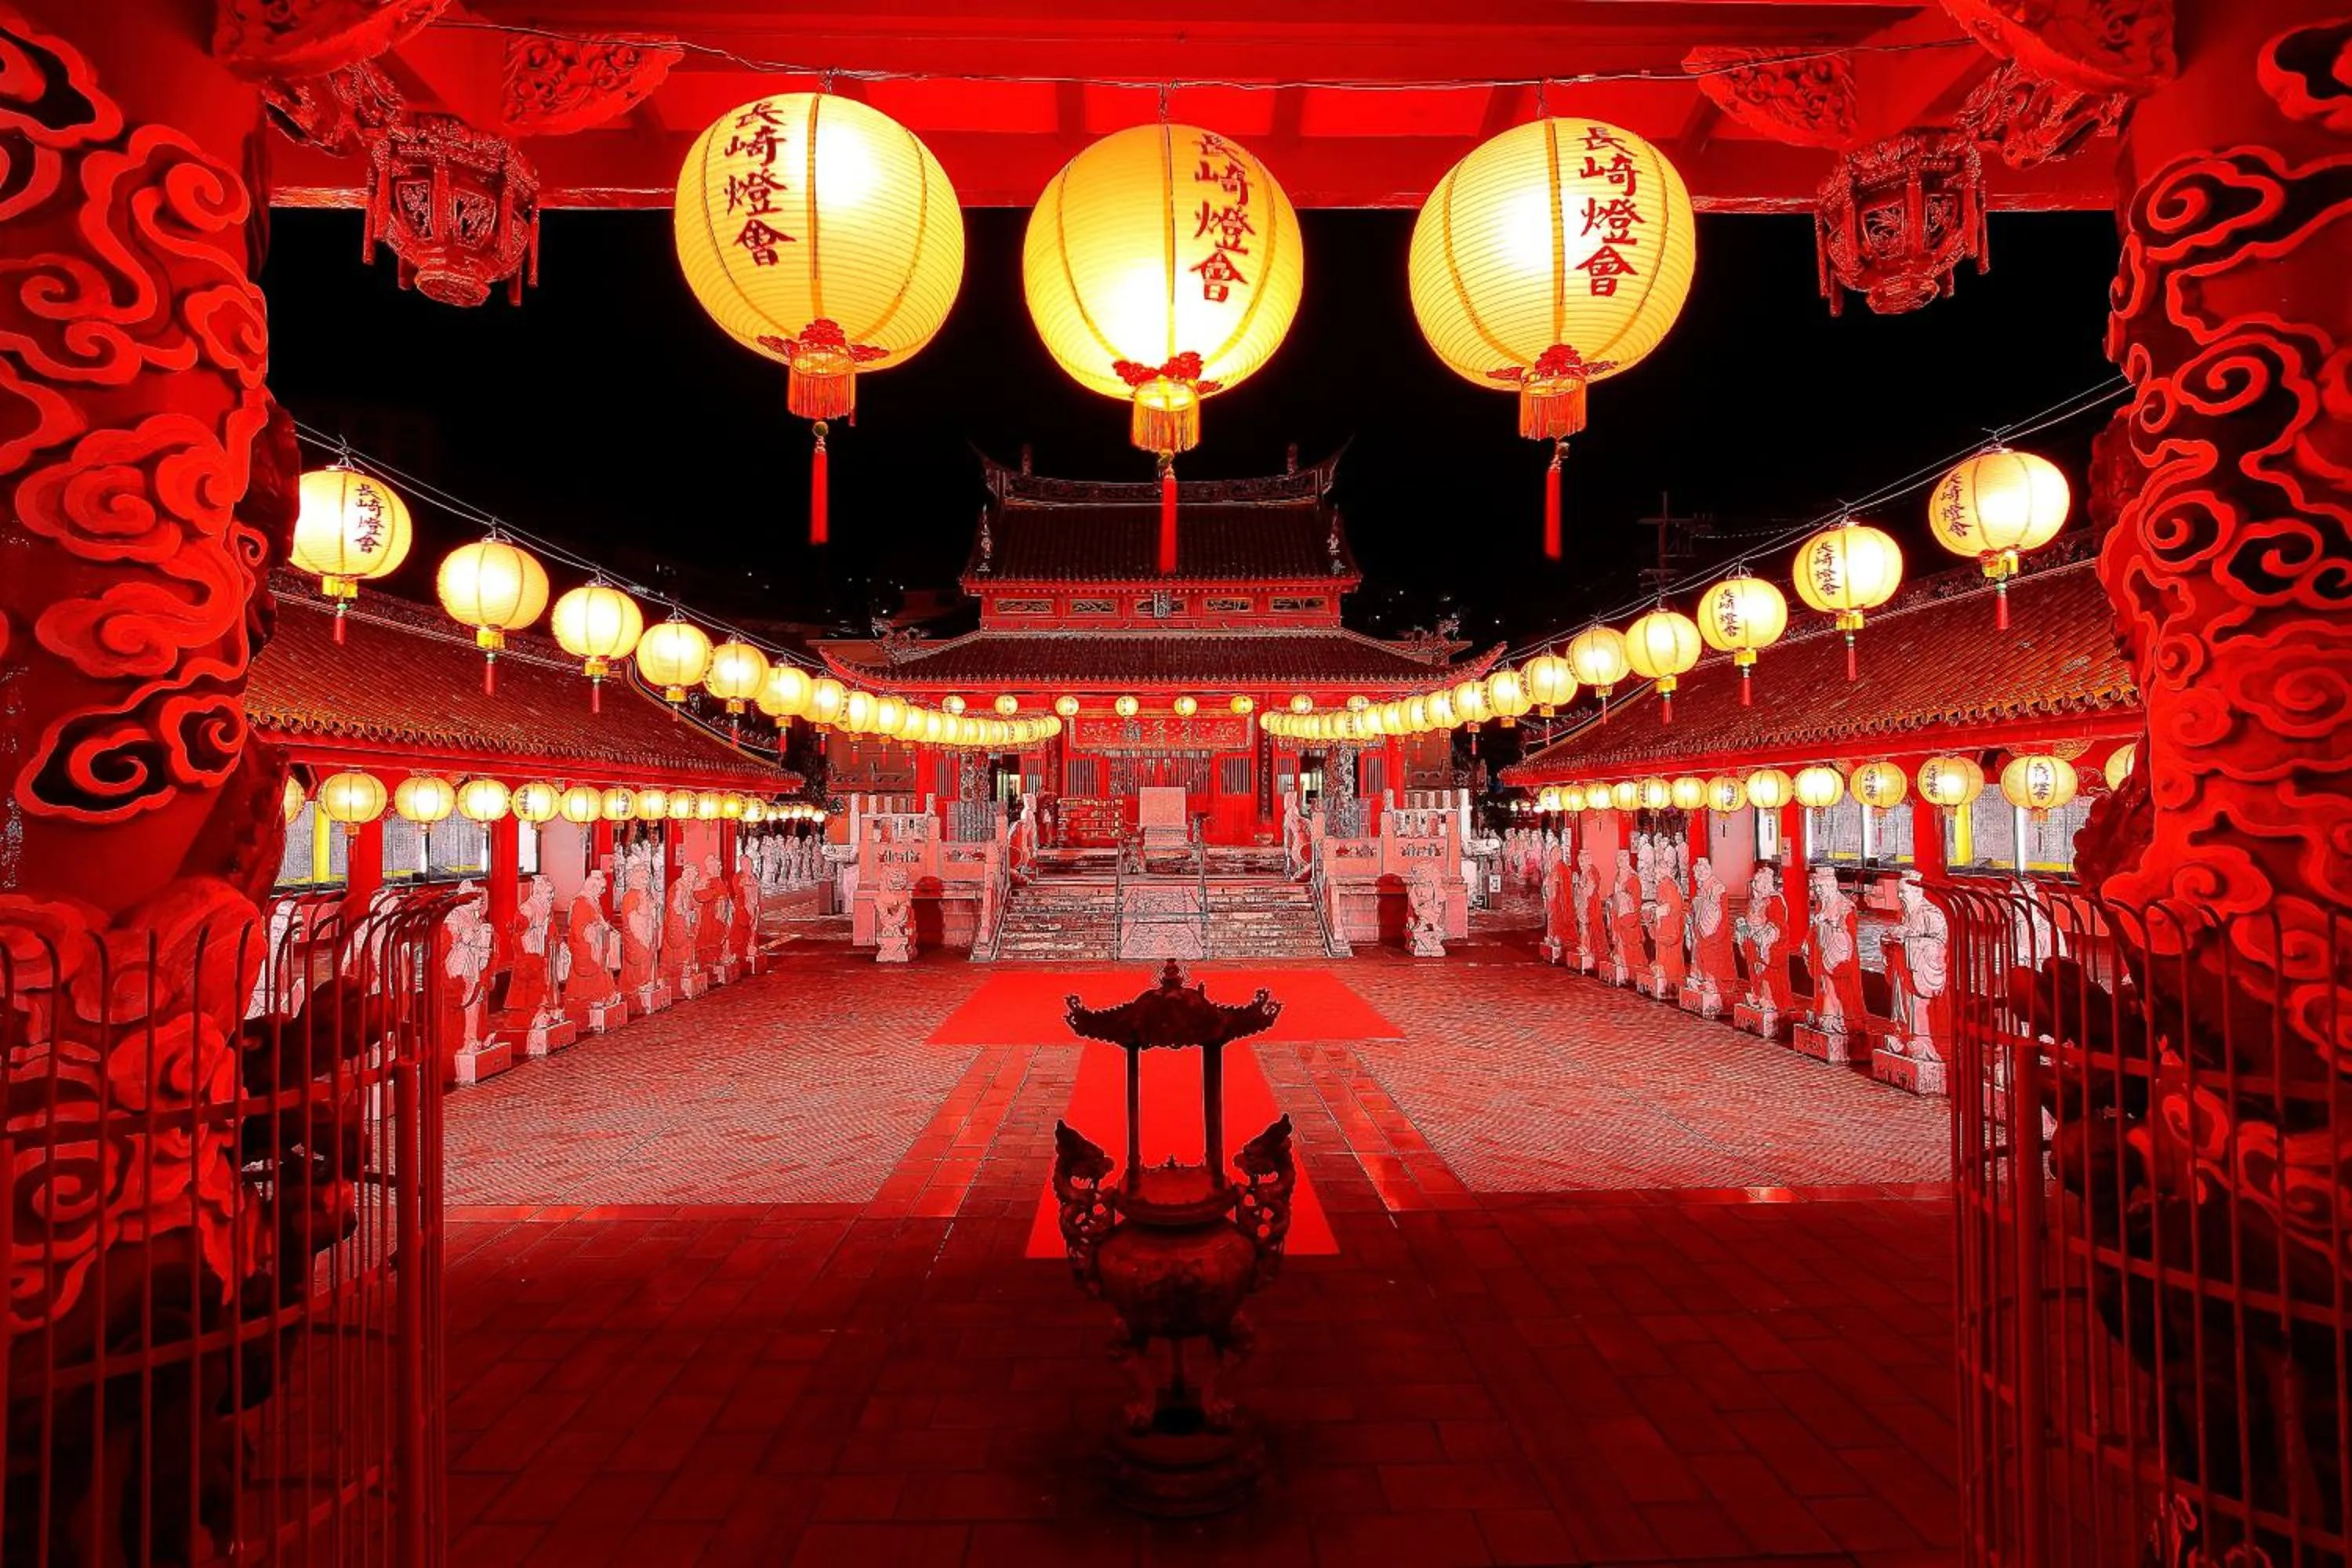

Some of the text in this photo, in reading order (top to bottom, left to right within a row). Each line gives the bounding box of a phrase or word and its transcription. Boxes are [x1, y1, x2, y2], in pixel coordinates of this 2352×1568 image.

[724, 102, 797, 267] 長崎燈會
[1189, 133, 1255, 303] 長崎燈會
[1576, 127, 1646, 296] 長崎燈會
[355, 483, 384, 554] 長崎燈會
